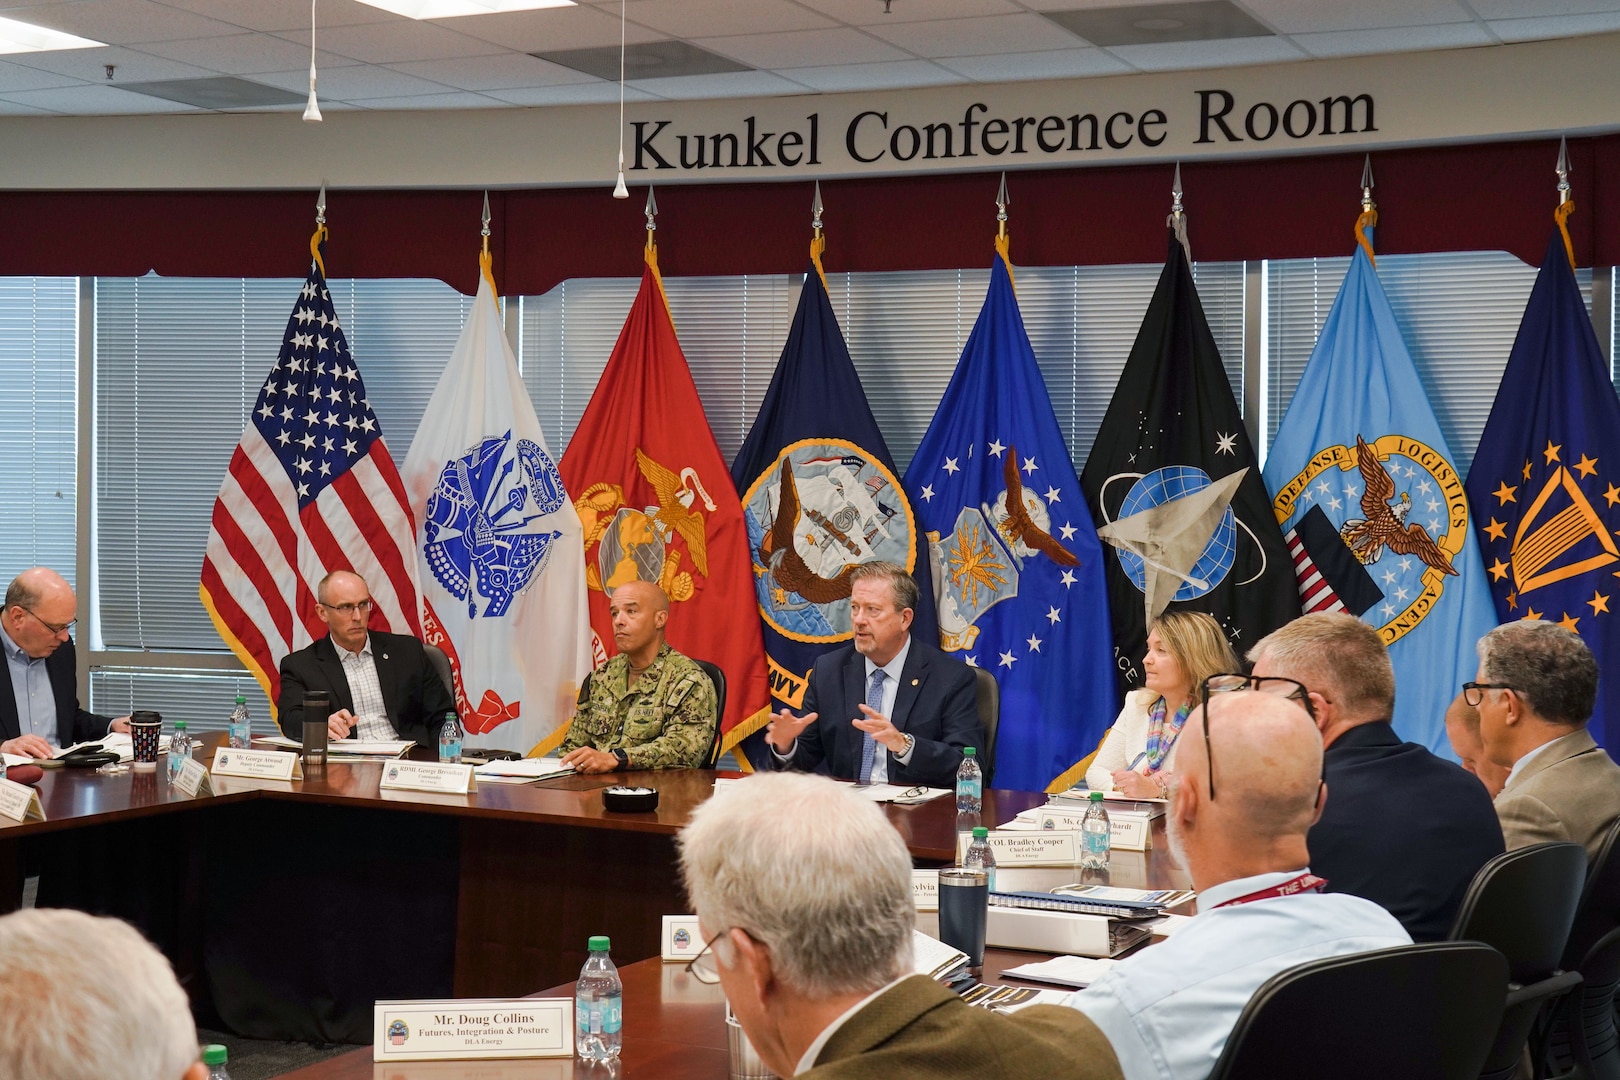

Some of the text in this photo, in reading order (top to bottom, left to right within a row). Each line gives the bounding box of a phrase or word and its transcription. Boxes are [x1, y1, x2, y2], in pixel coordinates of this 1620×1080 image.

[629, 90, 1378, 169] Kunkel Conference Room
[1278, 439, 1467, 529] DEFENSE LOGISTICS
[1383, 586, 1438, 643] AGENC
[1063, 817, 1075, 826] Ms.
[1008, 838, 1036, 848] Bradley
[1037, 838, 1065, 847] Cooper
[1277, 881, 1299, 897] THE
[434, 1012, 535, 1026] Mr. Doug Collins
[419, 1026, 550, 1037] Futures, Integration & Posture
[481, 1037, 503, 1045] Energy
